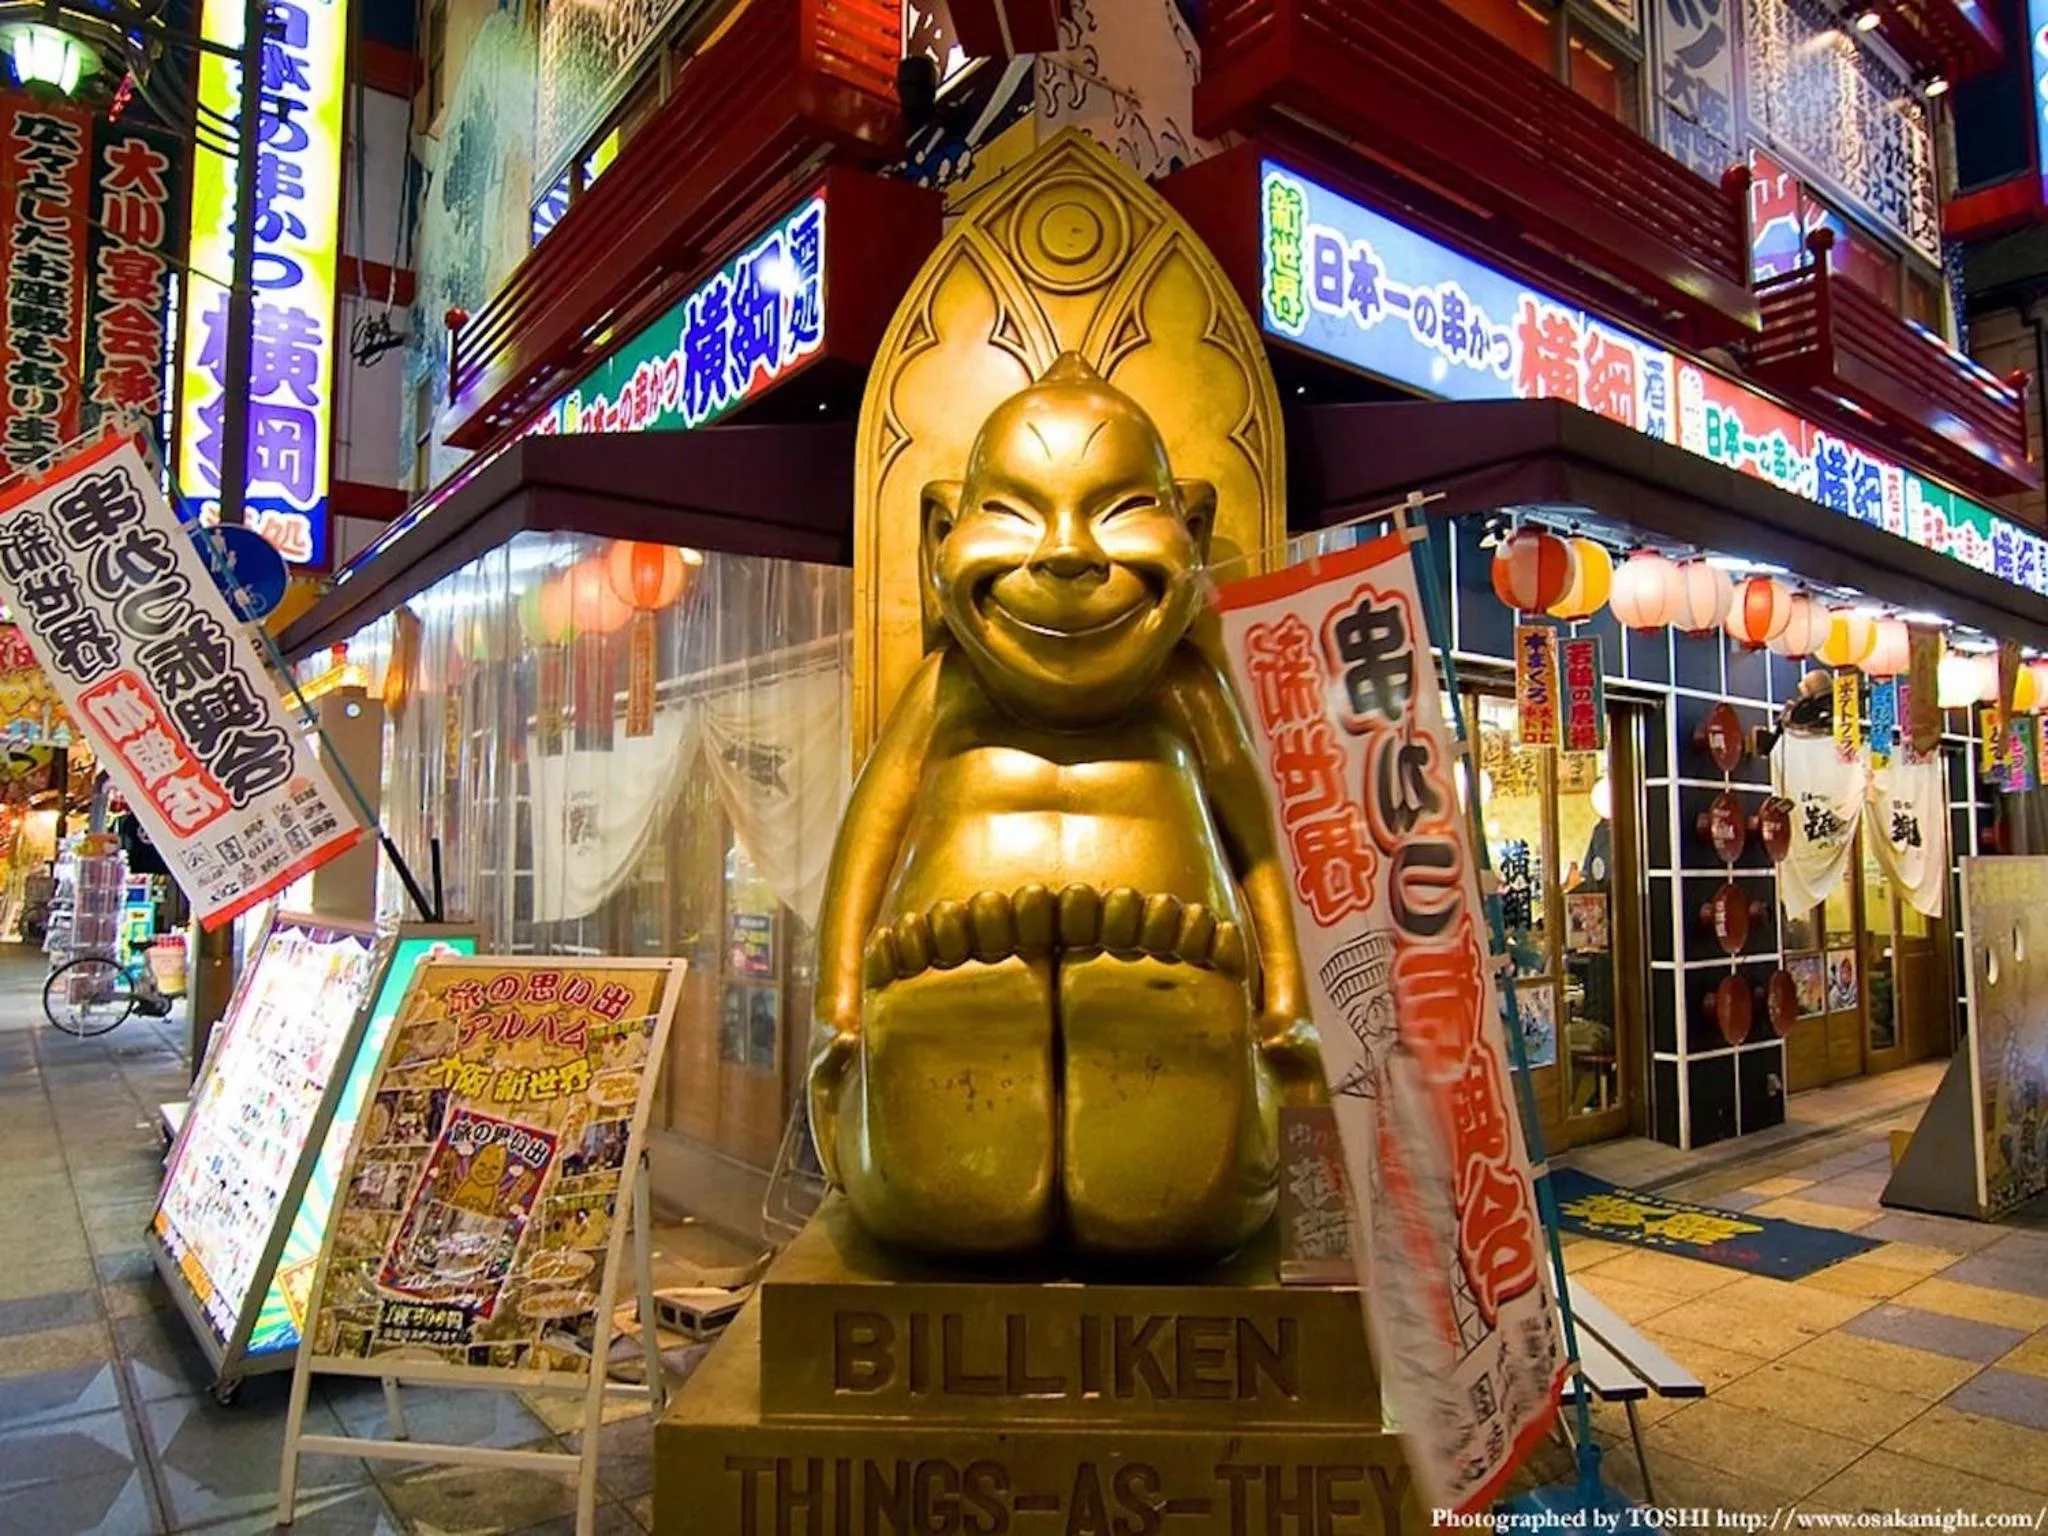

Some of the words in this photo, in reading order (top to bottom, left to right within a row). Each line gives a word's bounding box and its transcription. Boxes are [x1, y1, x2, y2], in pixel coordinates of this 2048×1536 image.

[1269, 178, 1303, 327] 新世界
[1313, 233, 1513, 372] 日本一の串かつ
[683, 236, 783, 420] 横綱
[1519, 300, 1637, 429] 横綱
[197, 293, 322, 503] 横綱
[1524, 632, 1548, 704] 本まぐろ
[447, 970, 633, 1021] 旅の思い出
[493, 1058, 592, 1102] 新世界
[450, 1118, 549, 1168] 旅の思い出
[833, 1311, 1300, 1400] BILLIKEN
